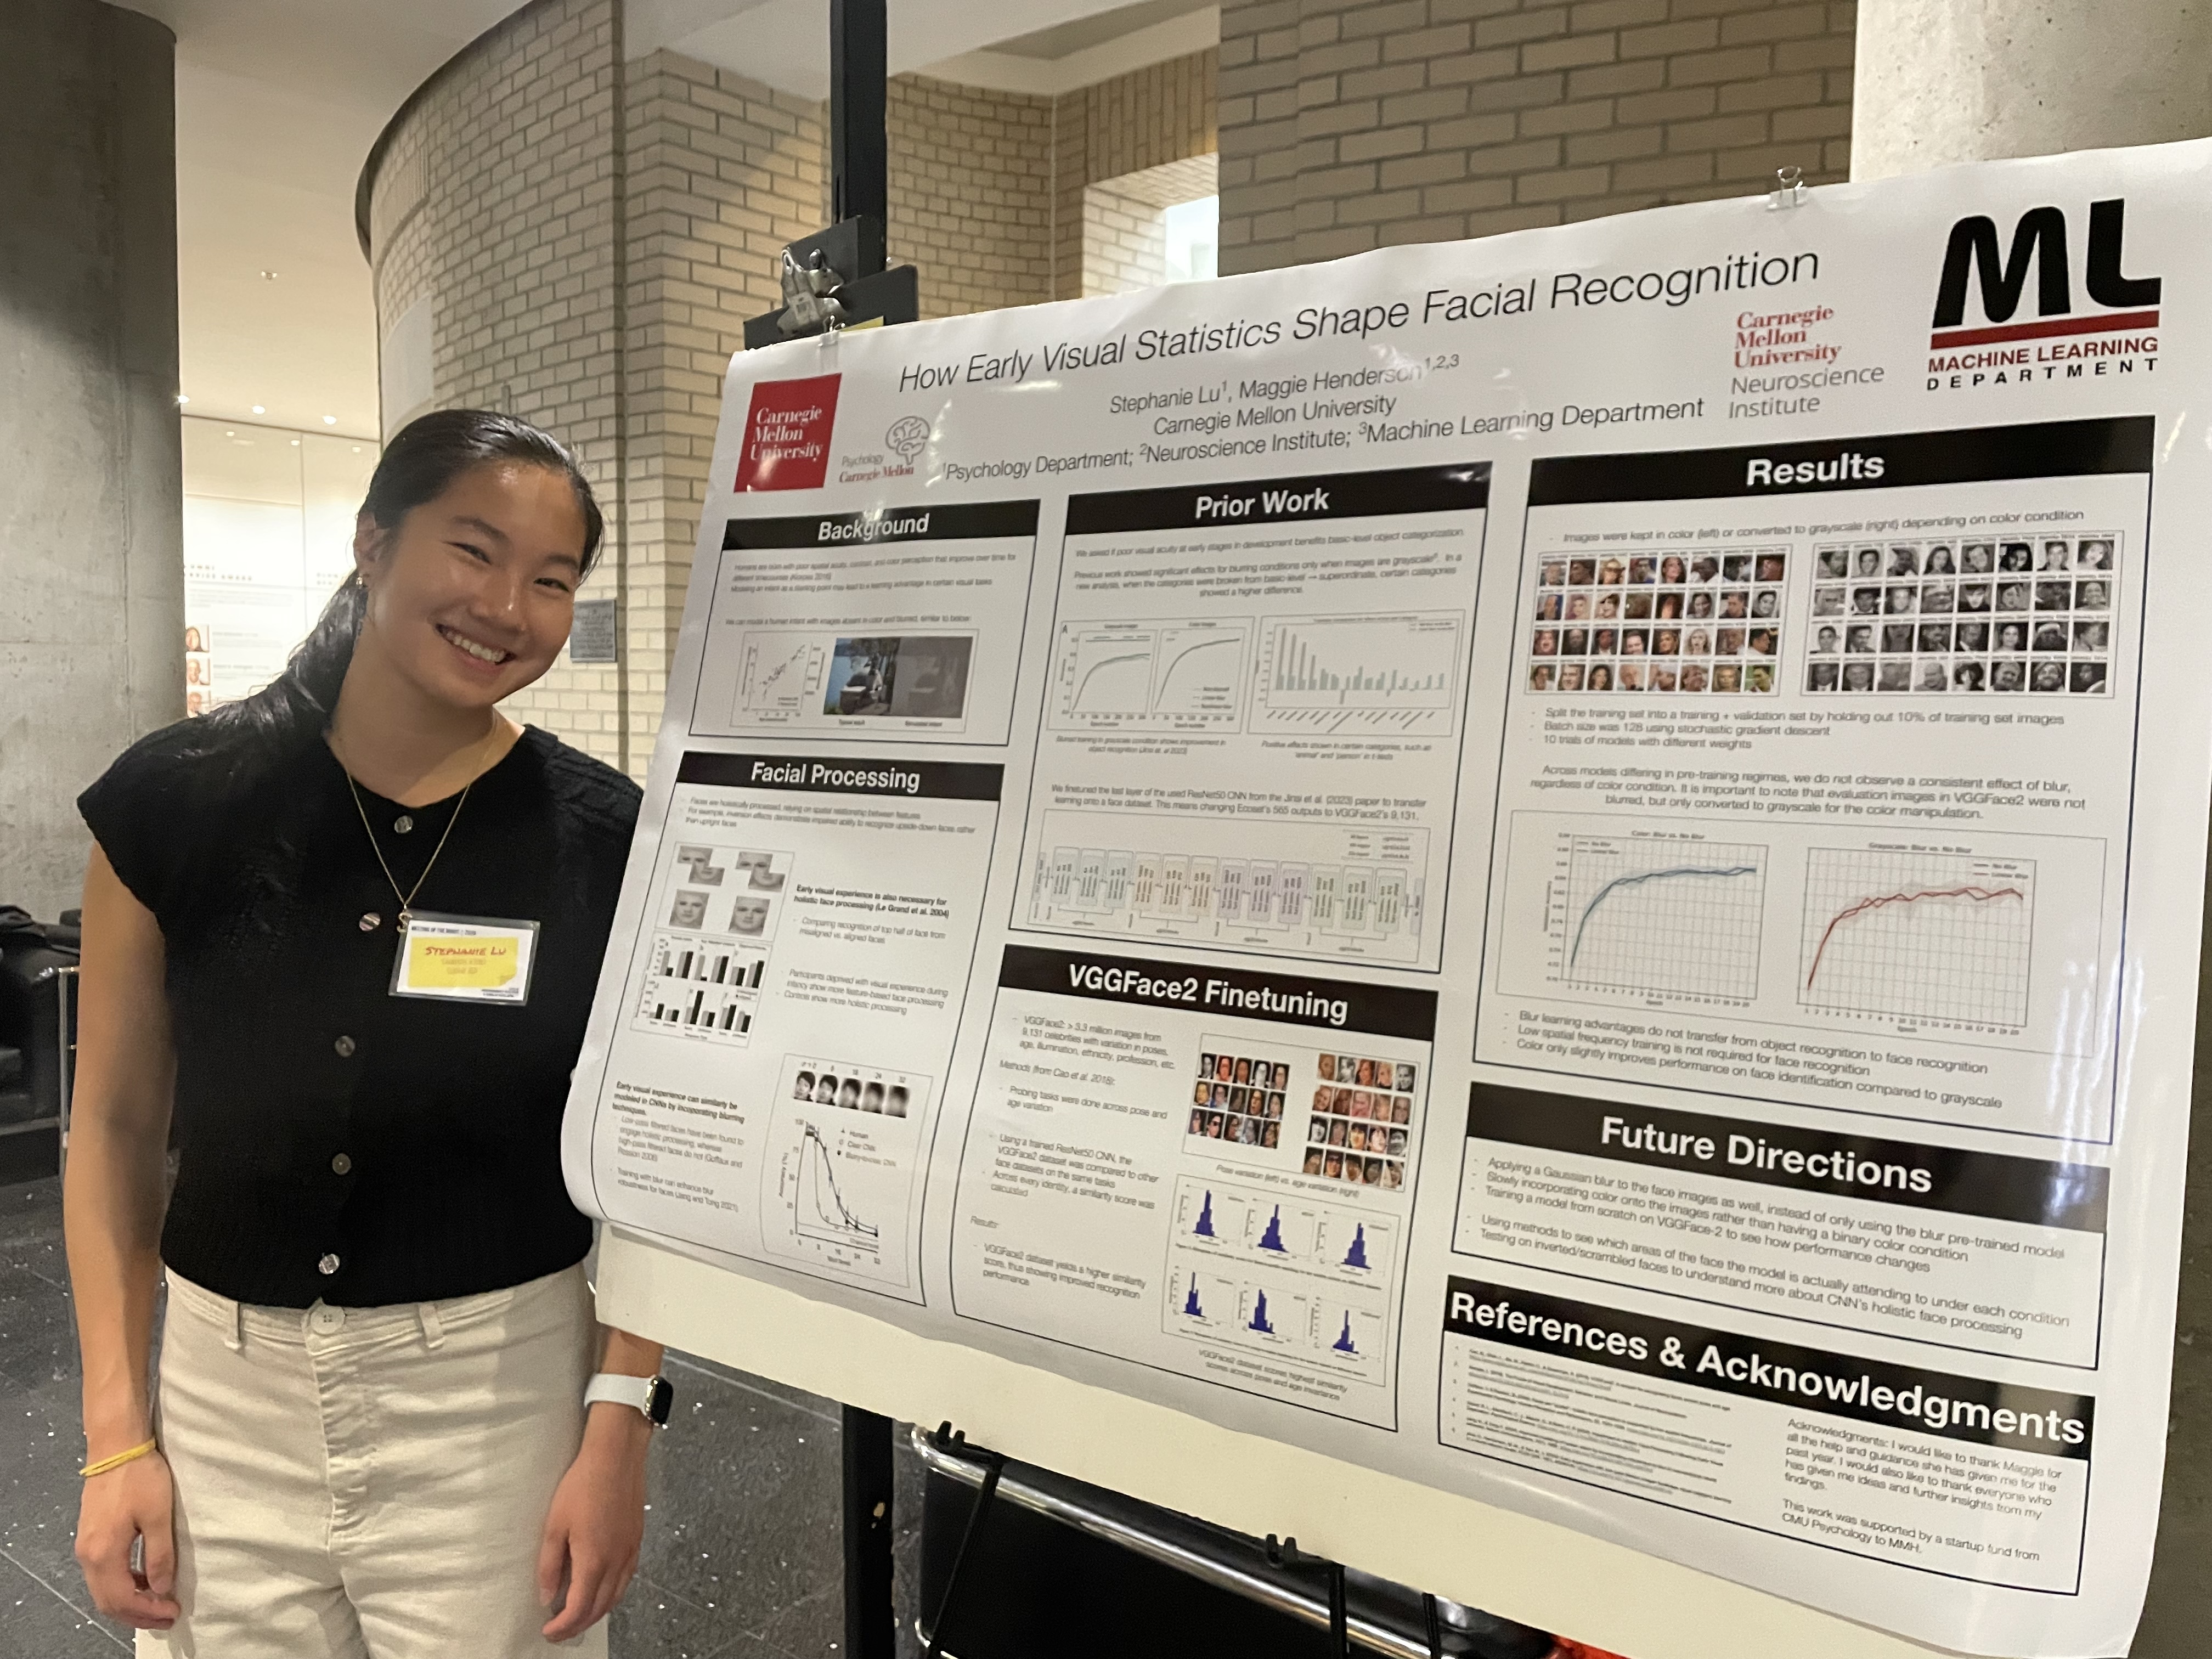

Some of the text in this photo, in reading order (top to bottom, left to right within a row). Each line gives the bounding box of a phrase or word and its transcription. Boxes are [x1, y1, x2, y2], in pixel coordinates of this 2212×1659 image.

[1932, 199, 2162, 329] ML
[899, 252, 1818, 392] How Early Visual Statistics Shape Facial Recognition
[1736, 306, 1834, 331] Carnegie
[1733, 342, 1843, 369] University
[1735, 326, 1807, 350] Mellon
[1928, 337, 2158, 373] MACHINE LEARNING
[1731, 364, 1885, 394] Neuroscience
[1927, 359, 2158, 391] DEPARTMENT
[1110, 388, 1193, 415] Stephanie
[1239, 375, 1307, 400] Maggie
[1728, 394, 1820, 419] Institute
[754, 425, 803, 443] Mellon
[757, 405, 822, 426] Carnegie
[1154, 395, 1397, 436] Carnegie Mellon University
[1035, 449, 1133, 475] Department;
[1272, 429, 1351, 452] Institute;
[1460, 410, 1554, 435] Learning
[1562, 398, 1704, 428] Department
[1747, 451, 1885, 486] Results
[1195, 488, 1329, 519] Prior Work
[818, 513, 930, 541] Background
[752, 761, 920, 793] Facial Processing
[1070, 964, 1348, 1025] VGGFace2 Finetuning
[1518, 1024, 1541, 1036] Low
[1578, 1031, 1629, 1049] frequency
[1632, 1039, 1671, 1054] training
[1674, 1043, 1683, 1054] is
[1685, 1046, 1703, 1056] not
[1706, 1049, 1753, 1062] required
[1756, 1053, 1772, 1064] for
[1775, 1055, 1800, 1068] face
[1803, 1060, 1870, 1076] recognition
[1519, 1011, 1539, 1022] Blur
[1584, 1019, 1645, 1036] advantages
[1648, 1026, 1663, 1036] do
[1665, 1029, 1683, 1039] not
[1686, 1030, 1729, 1043] transfer
[1731, 1035, 1757, 1047] from
[1760, 1040, 1796, 1052] object
[1799, 1045, 1866, 1060] recognition
[1870, 1051, 1883, 1062] to
[1886, 1053, 1913, 1065] face
[1916, 1058, 1988, 1074] recognition
[1517, 1039, 1544, 1051] Color
[1547, 1044, 1568, 1056] only
[1608, 1051, 1656, 1065] improves
[1659, 1058, 1729, 1074] performance
[1732, 1068, 1747, 1076] on
[1750, 1067, 1775, 1080] face
[1778, 1071, 1853, 1090] identification
[1856, 1083, 1921, 1098] compared
[1924, 1089, 1937, 1101] to
[1940, 1093, 2002, 1108] grayscale
[1601, 1115, 1933, 1193] Future Directions
[1487, 1172, 1968, 1262] Slowly incorporating color onto the images rather than having a binary color condition
[1481, 1228, 1516, 1246] Testing
[1518, 1238, 1532, 1247] on
[1639, 1259, 1668, 1274] faces
[1671, 1265, 1683, 1276] to
[1685, 1269, 1751, 1290] understand
[1753, 1283, 1785, 1296] more
[1788, 1288, 1824, 1304] about
[1872, 1301, 1915, 1319] holistic
[1920, 1310, 1948, 1325] face
[1950, 1317, 2023, 1339] processing
[1451, 1292, 1649, 1362] References
[1660, 1336, 1686, 1369] &
[1697, 1345, 2085, 1444] Acknowledgments
